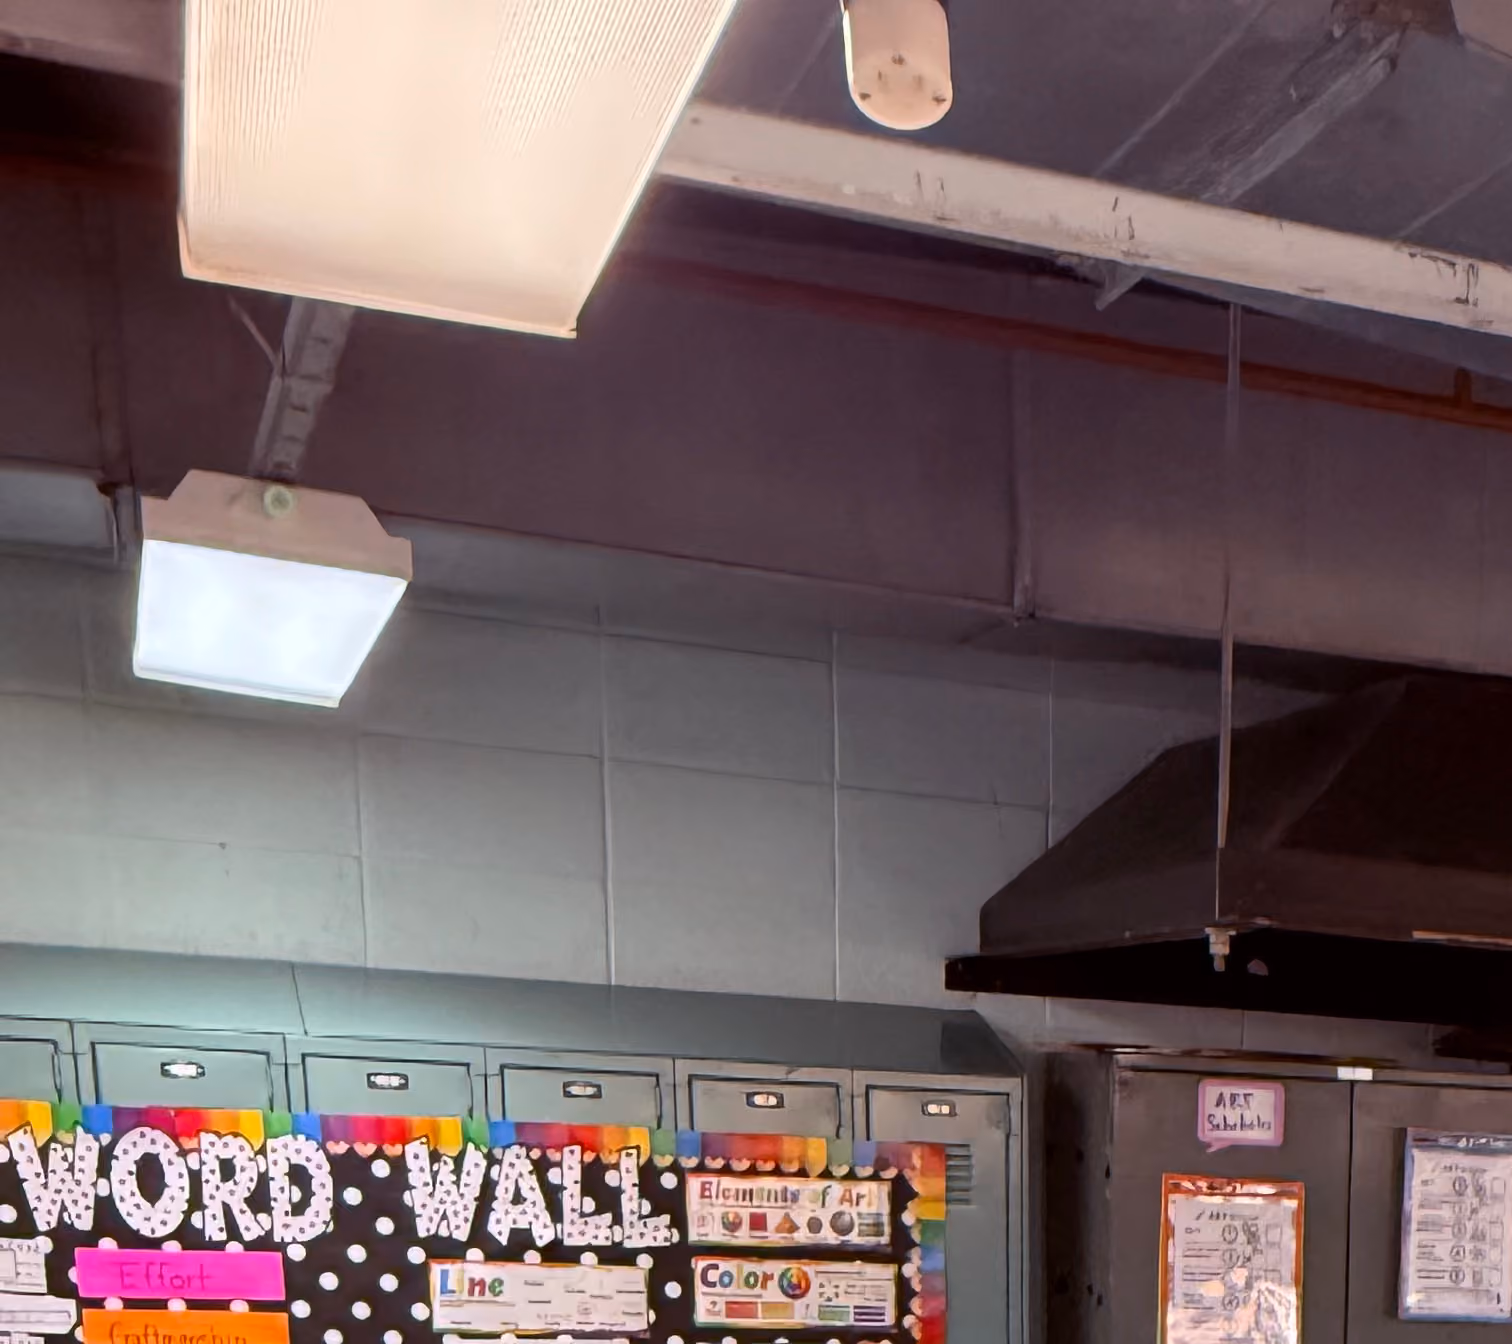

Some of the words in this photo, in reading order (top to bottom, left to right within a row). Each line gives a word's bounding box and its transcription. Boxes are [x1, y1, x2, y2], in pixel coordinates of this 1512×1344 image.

[8, 1121, 334, 1243] WORD
[404, 1136, 672, 1248] WALL
[119, 1259, 214, 1292] Effort
[438, 1269, 505, 1298] Line
[700, 1262, 775, 1291] Color
